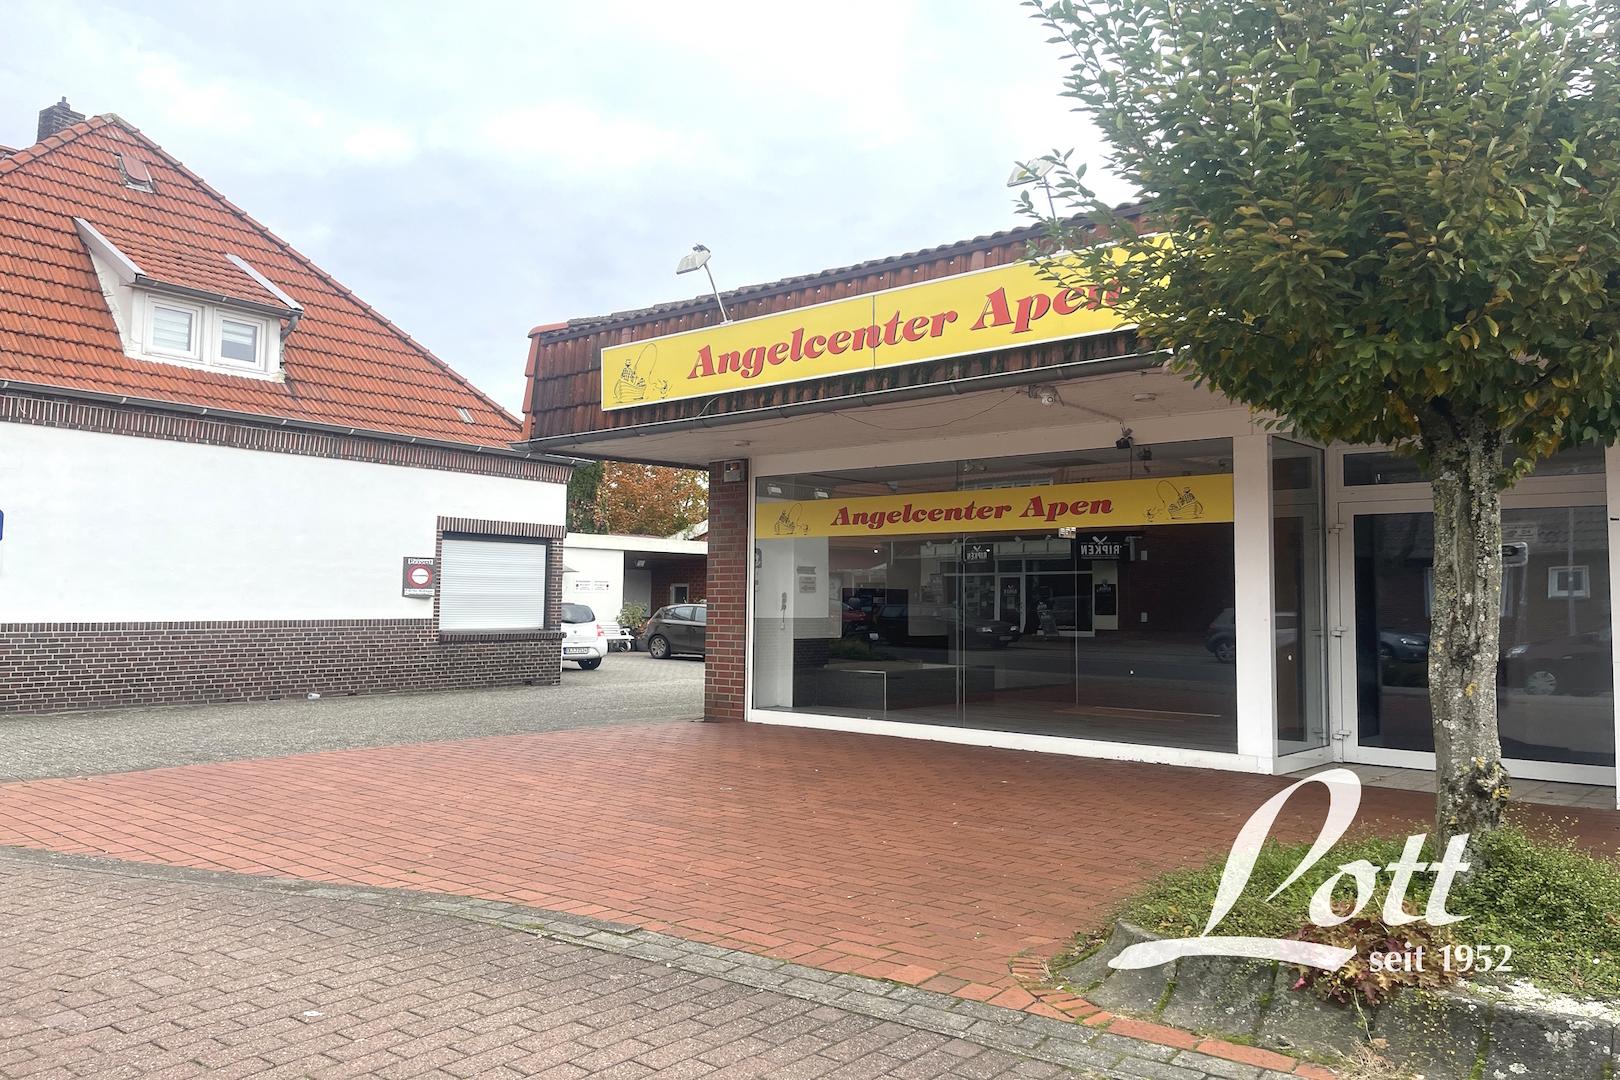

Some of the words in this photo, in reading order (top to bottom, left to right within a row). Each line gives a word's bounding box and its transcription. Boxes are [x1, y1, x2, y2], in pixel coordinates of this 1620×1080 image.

[687, 310, 959, 379] Angelcenter
[830, 500, 1012, 530] Angelcenter
[1019, 495, 1114, 522] Apen
